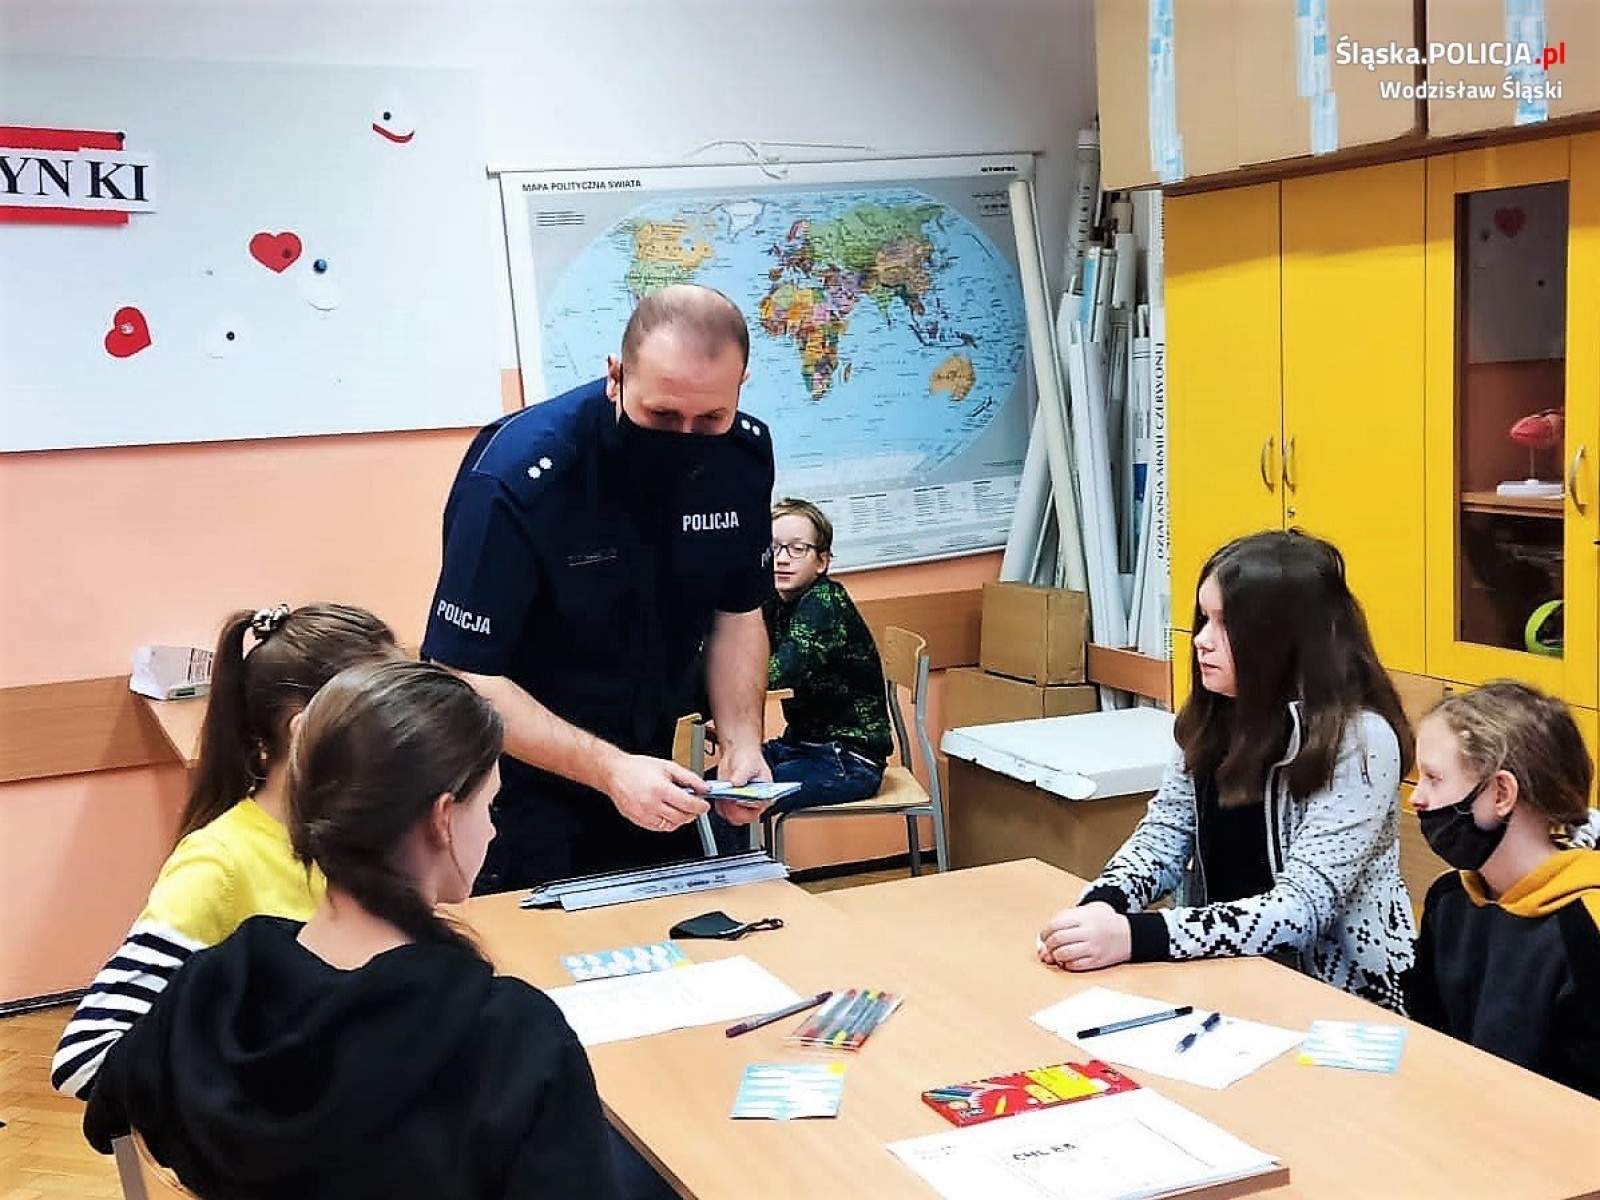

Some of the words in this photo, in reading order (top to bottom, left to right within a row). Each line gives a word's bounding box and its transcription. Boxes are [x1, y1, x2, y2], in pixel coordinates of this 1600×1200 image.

[522, 183, 549, 192] MAPA
[551, 181, 606, 190] POLITYCZNA
[682, 511, 740, 532] POLICJA
[436, 599, 492, 635] POLICJA
